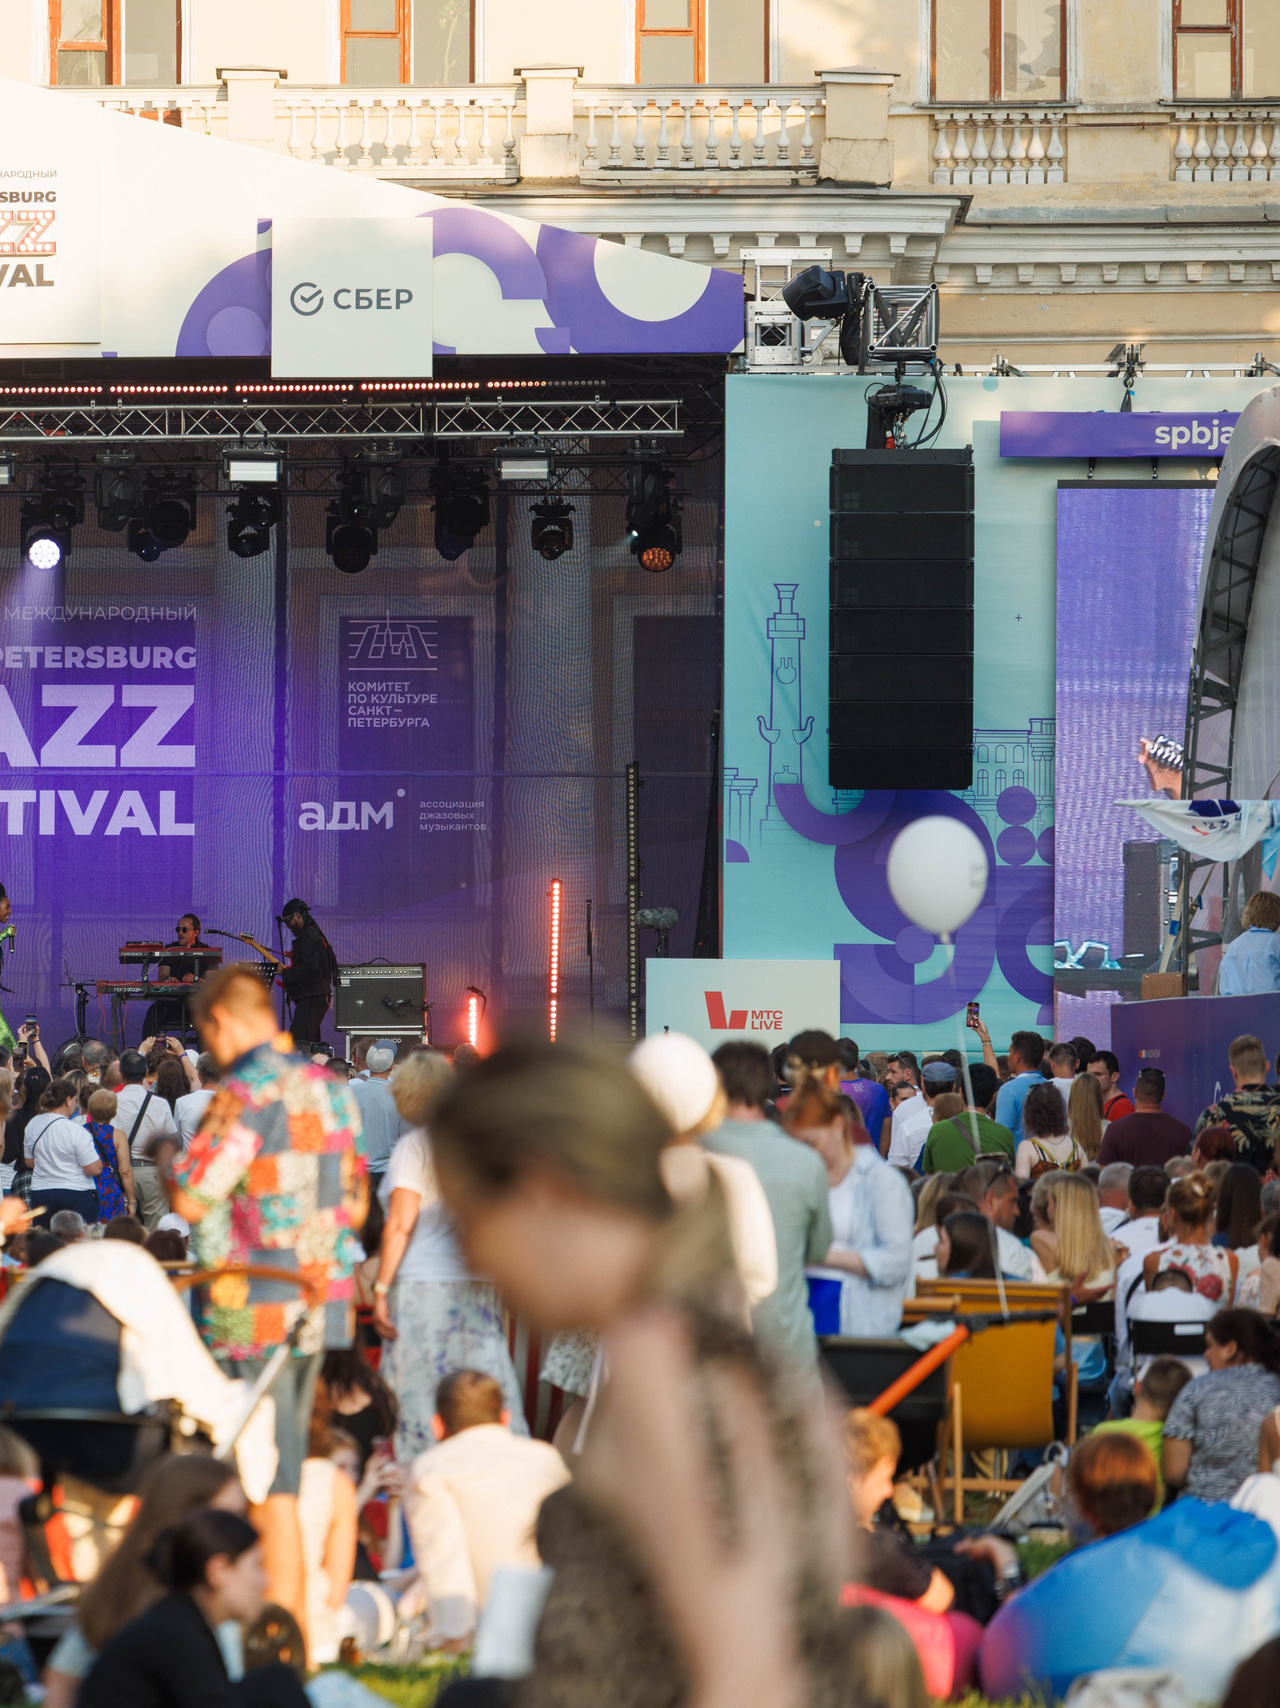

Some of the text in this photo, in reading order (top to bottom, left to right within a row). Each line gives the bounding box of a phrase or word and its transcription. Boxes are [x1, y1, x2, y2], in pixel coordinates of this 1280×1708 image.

[333, 288, 413, 310] СБЕР
[5, 604, 197, 623] МЕЖДУНАРОДНЫЙ
[348, 682, 410, 692] КОМИТЕТ
[348, 694, 438, 704] ПО КУЛЬТУРЕ
[348, 718, 430, 728] ПЕТЕРБУРГА
[420, 801, 485, 809] ассоциация
[420, 812, 475, 820] джазовых
[420, 823, 487, 833] музыкантов
[751, 1020, 783, 1030] LIVE
